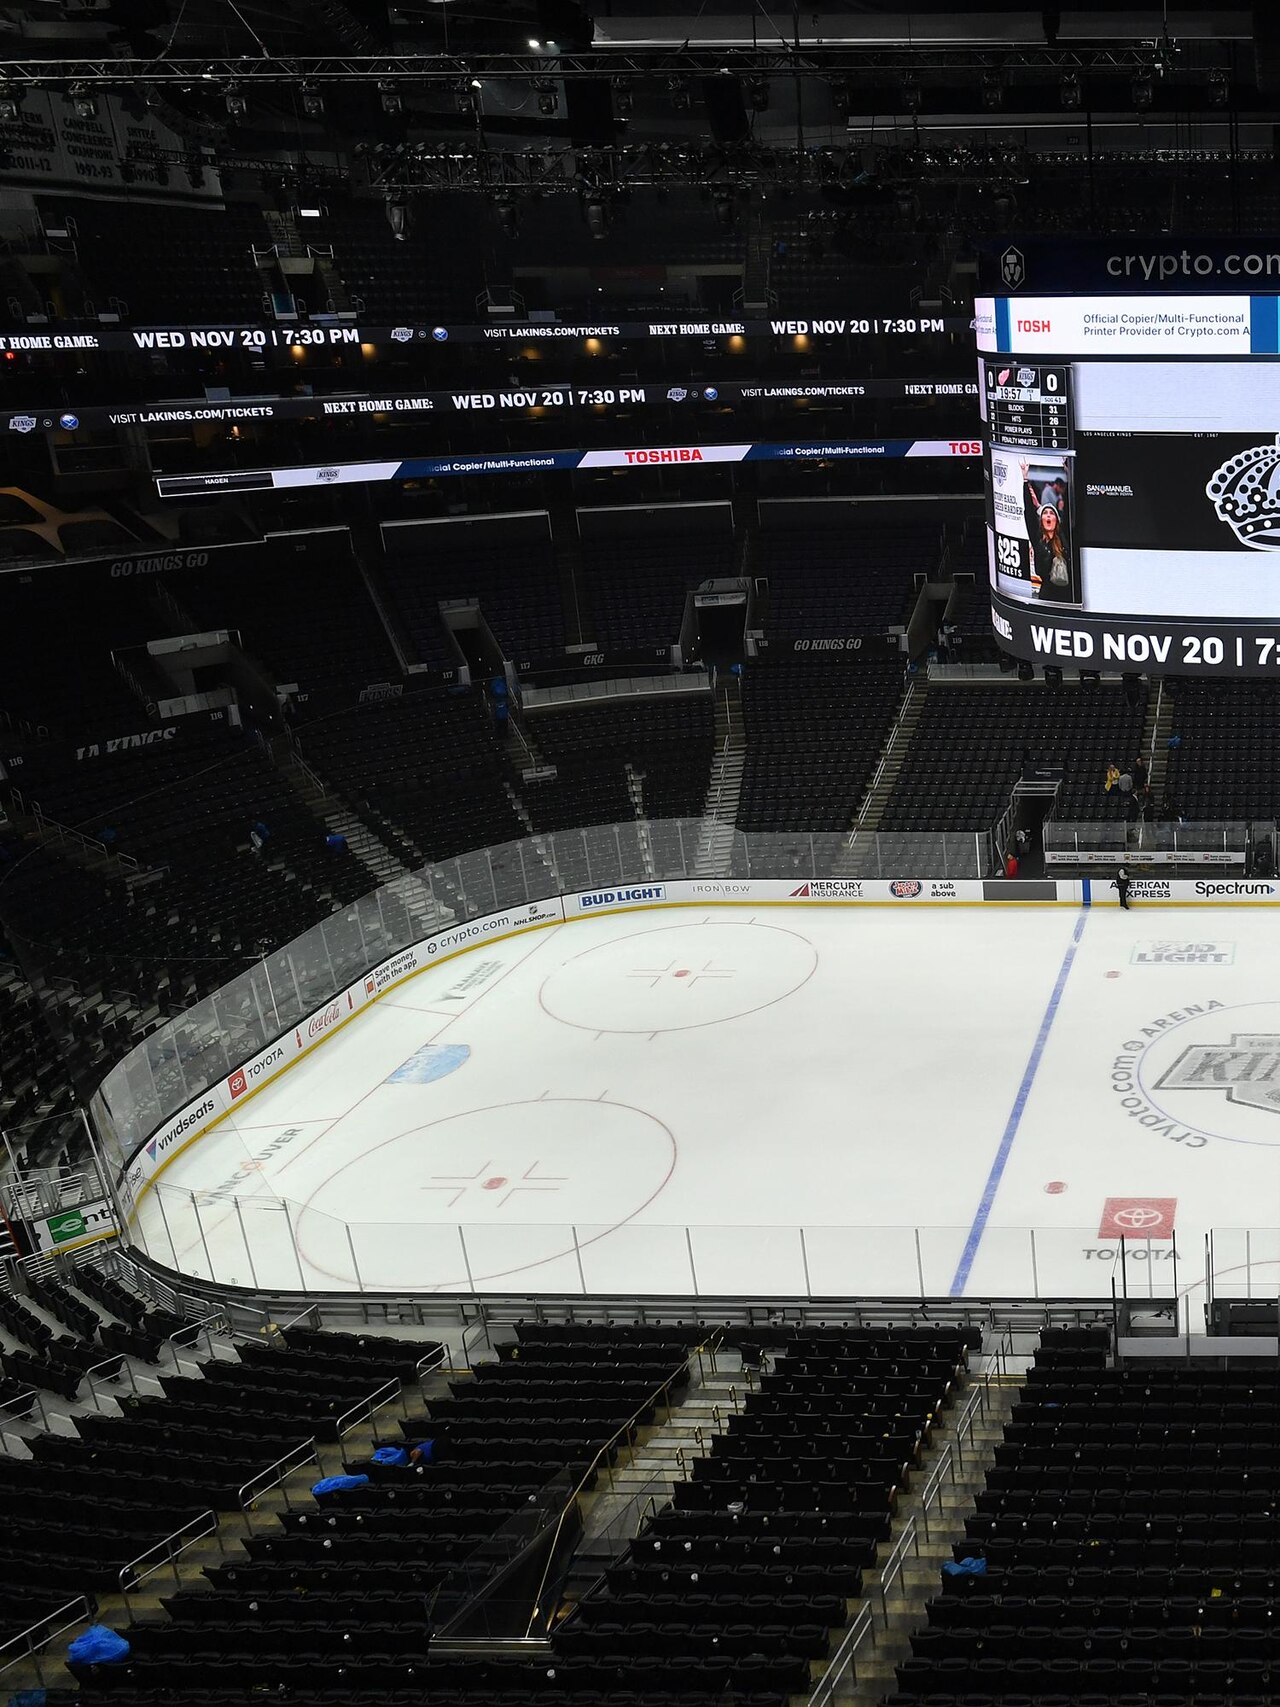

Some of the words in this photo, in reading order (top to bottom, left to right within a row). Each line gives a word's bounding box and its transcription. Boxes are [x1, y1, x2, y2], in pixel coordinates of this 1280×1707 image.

[770, 320, 808, 335] WED
[812, 320, 846, 334] NOV
[849, 319, 870, 334] 20
[882, 319, 917, 334] 7:30
[920, 318, 945, 333] PM
[1083, 313, 1119, 324] Official
[1120, 313, 1244, 325] Copier/Multi-Functional
[483, 328, 507, 338] VISIT
[509, 326, 620, 337] LAKINGS.COM/TICKETS
[648, 324, 678, 336] NEXT
[680, 323, 711, 335] HOME
[712, 323, 745, 335] GAME:
[1083, 326, 1117, 336] Printer
[1119, 326, 1162, 336] Provider
[1164, 326, 1175, 336] of
[1177, 326, 1240, 338] Crypto.com
[132, 332, 186, 349] WED
[192, 331, 236, 348] NOV
[240, 330, 267, 348] 20
[283, 329, 325, 347] 7:30
[329, 328, 361, 346] PM
[323, 401, 357, 414] NEXT
[357, 399, 394, 413] HOME
[395, 398, 434, 412] GAME:
[451, 394, 496, 410] WED
[499, 392, 541, 409] NOV
[542, 391, 564, 406] 20
[577, 390, 615, 406] 7:30
[618, 389, 646, 404] PM
[108, 413, 137, 424] VISIT
[139, 406, 274, 423] LAKINGS.COM/TICKETS
[626, 449, 704, 464] TOSHIBA
[452, 457, 555, 472] Copier/Multi-Functional
[998, 536, 1021, 569] $25
[110, 562, 133, 578] GO
[135, 555, 184, 575] KINGS
[185, 552, 209, 568] GO
[793, 639, 810, 651] GO
[810, 638, 845, 651] KINGS
[845, 638, 862, 650] GO
[1030, 624, 1094, 659] WED
[1102, 633, 1173, 664] NOV
[1181, 636, 1225, 666] 20
[692, 885, 720, 893] IRON
[725, 885, 751, 893] BOW
[810, 881, 862, 890] MERCURY
[930, 889, 957, 897] above
[939, 881, 955, 890] sub
[1109, 881, 1170, 890] AERICAN
[1195, 881, 1270, 898] Spectrum
[581, 894, 616, 908] BUD
[617, 887, 663, 902] LIGHT
[810, 889, 864, 898] INSURANCE
[1120, 890, 1171, 898] XPRESS
[440, 916, 510, 949] crypto.com
[374, 966, 390, 980] Save
[390, 951, 414, 970] money
[376, 974, 391, 988] with
[391, 967, 403, 979] the
[403, 959, 418, 972] app
[247, 1047, 284, 1079] TOYOTA
[158, 1100, 216, 1151] vividseats
[1082, 1248, 1182, 1262] TOYOTA
